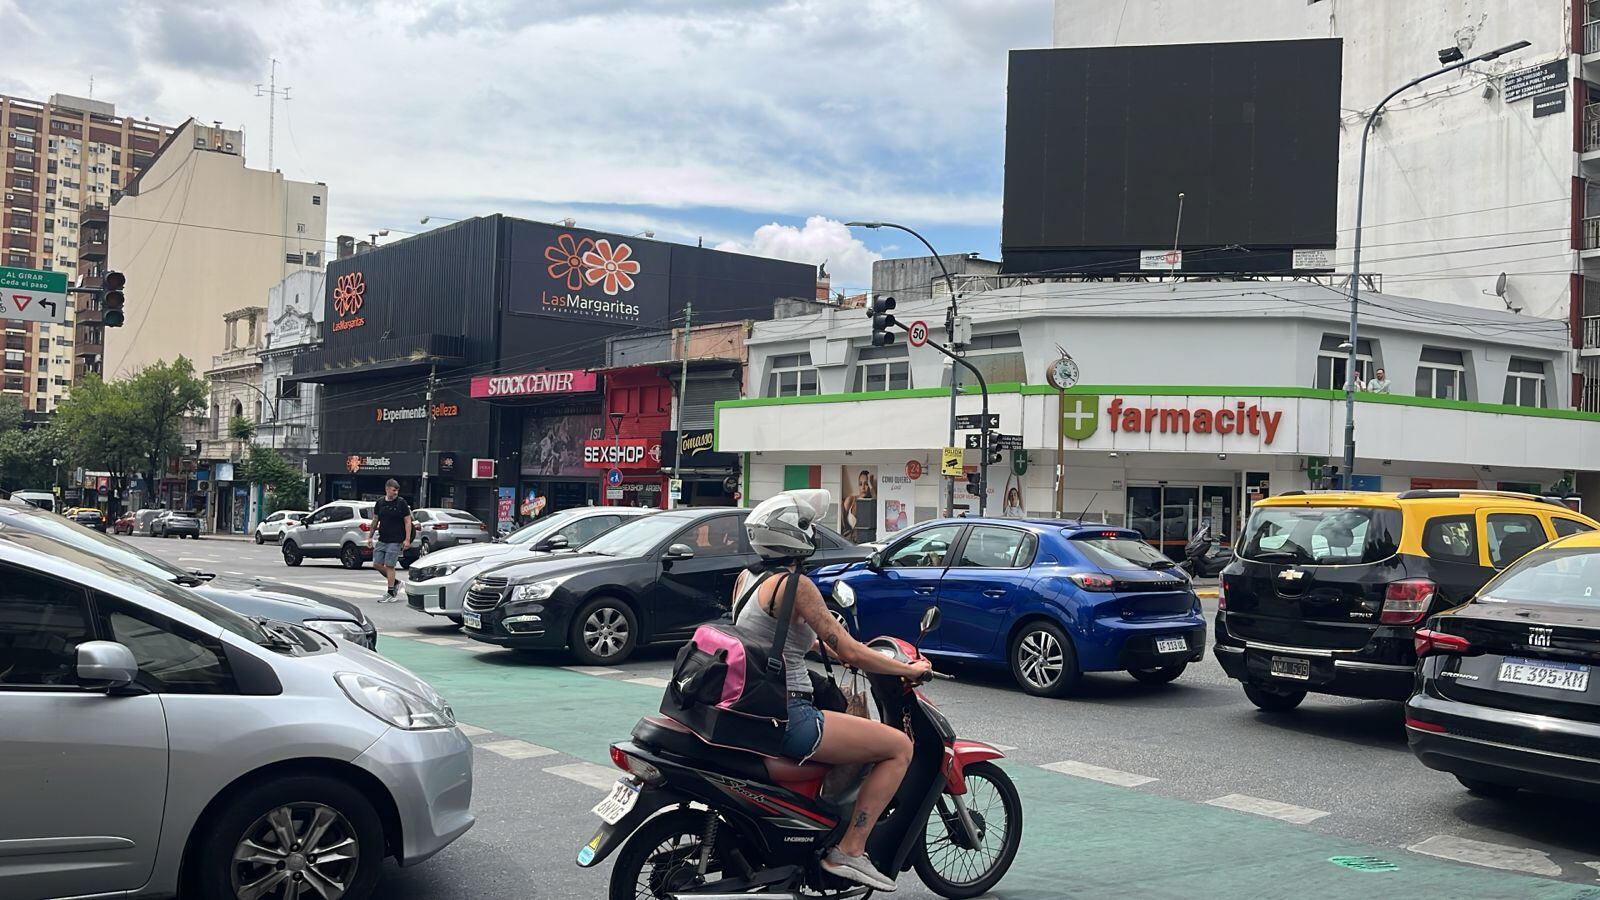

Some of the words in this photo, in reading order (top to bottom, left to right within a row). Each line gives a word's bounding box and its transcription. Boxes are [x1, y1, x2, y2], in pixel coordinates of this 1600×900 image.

[18, 272, 43, 280] GIRAR
[542, 290, 640, 316] LasMargaritas
[913, 328, 924, 339] 50
[488, 374, 526, 395] STOCK
[527, 373, 574, 393] CENTER
[383, 405, 427, 422] Experimentá
[1107, 398, 1282, 444] farmacity
[584, 446, 643, 462] SEXSHOP
[1528, 627, 1552, 647] FIAT
[1440, 671, 1479, 680] CRONOS
[1503, 665, 1523, 680] AE
[1527, 667, 1557, 685] 395
[1562, 672, 1584, 688] XM
